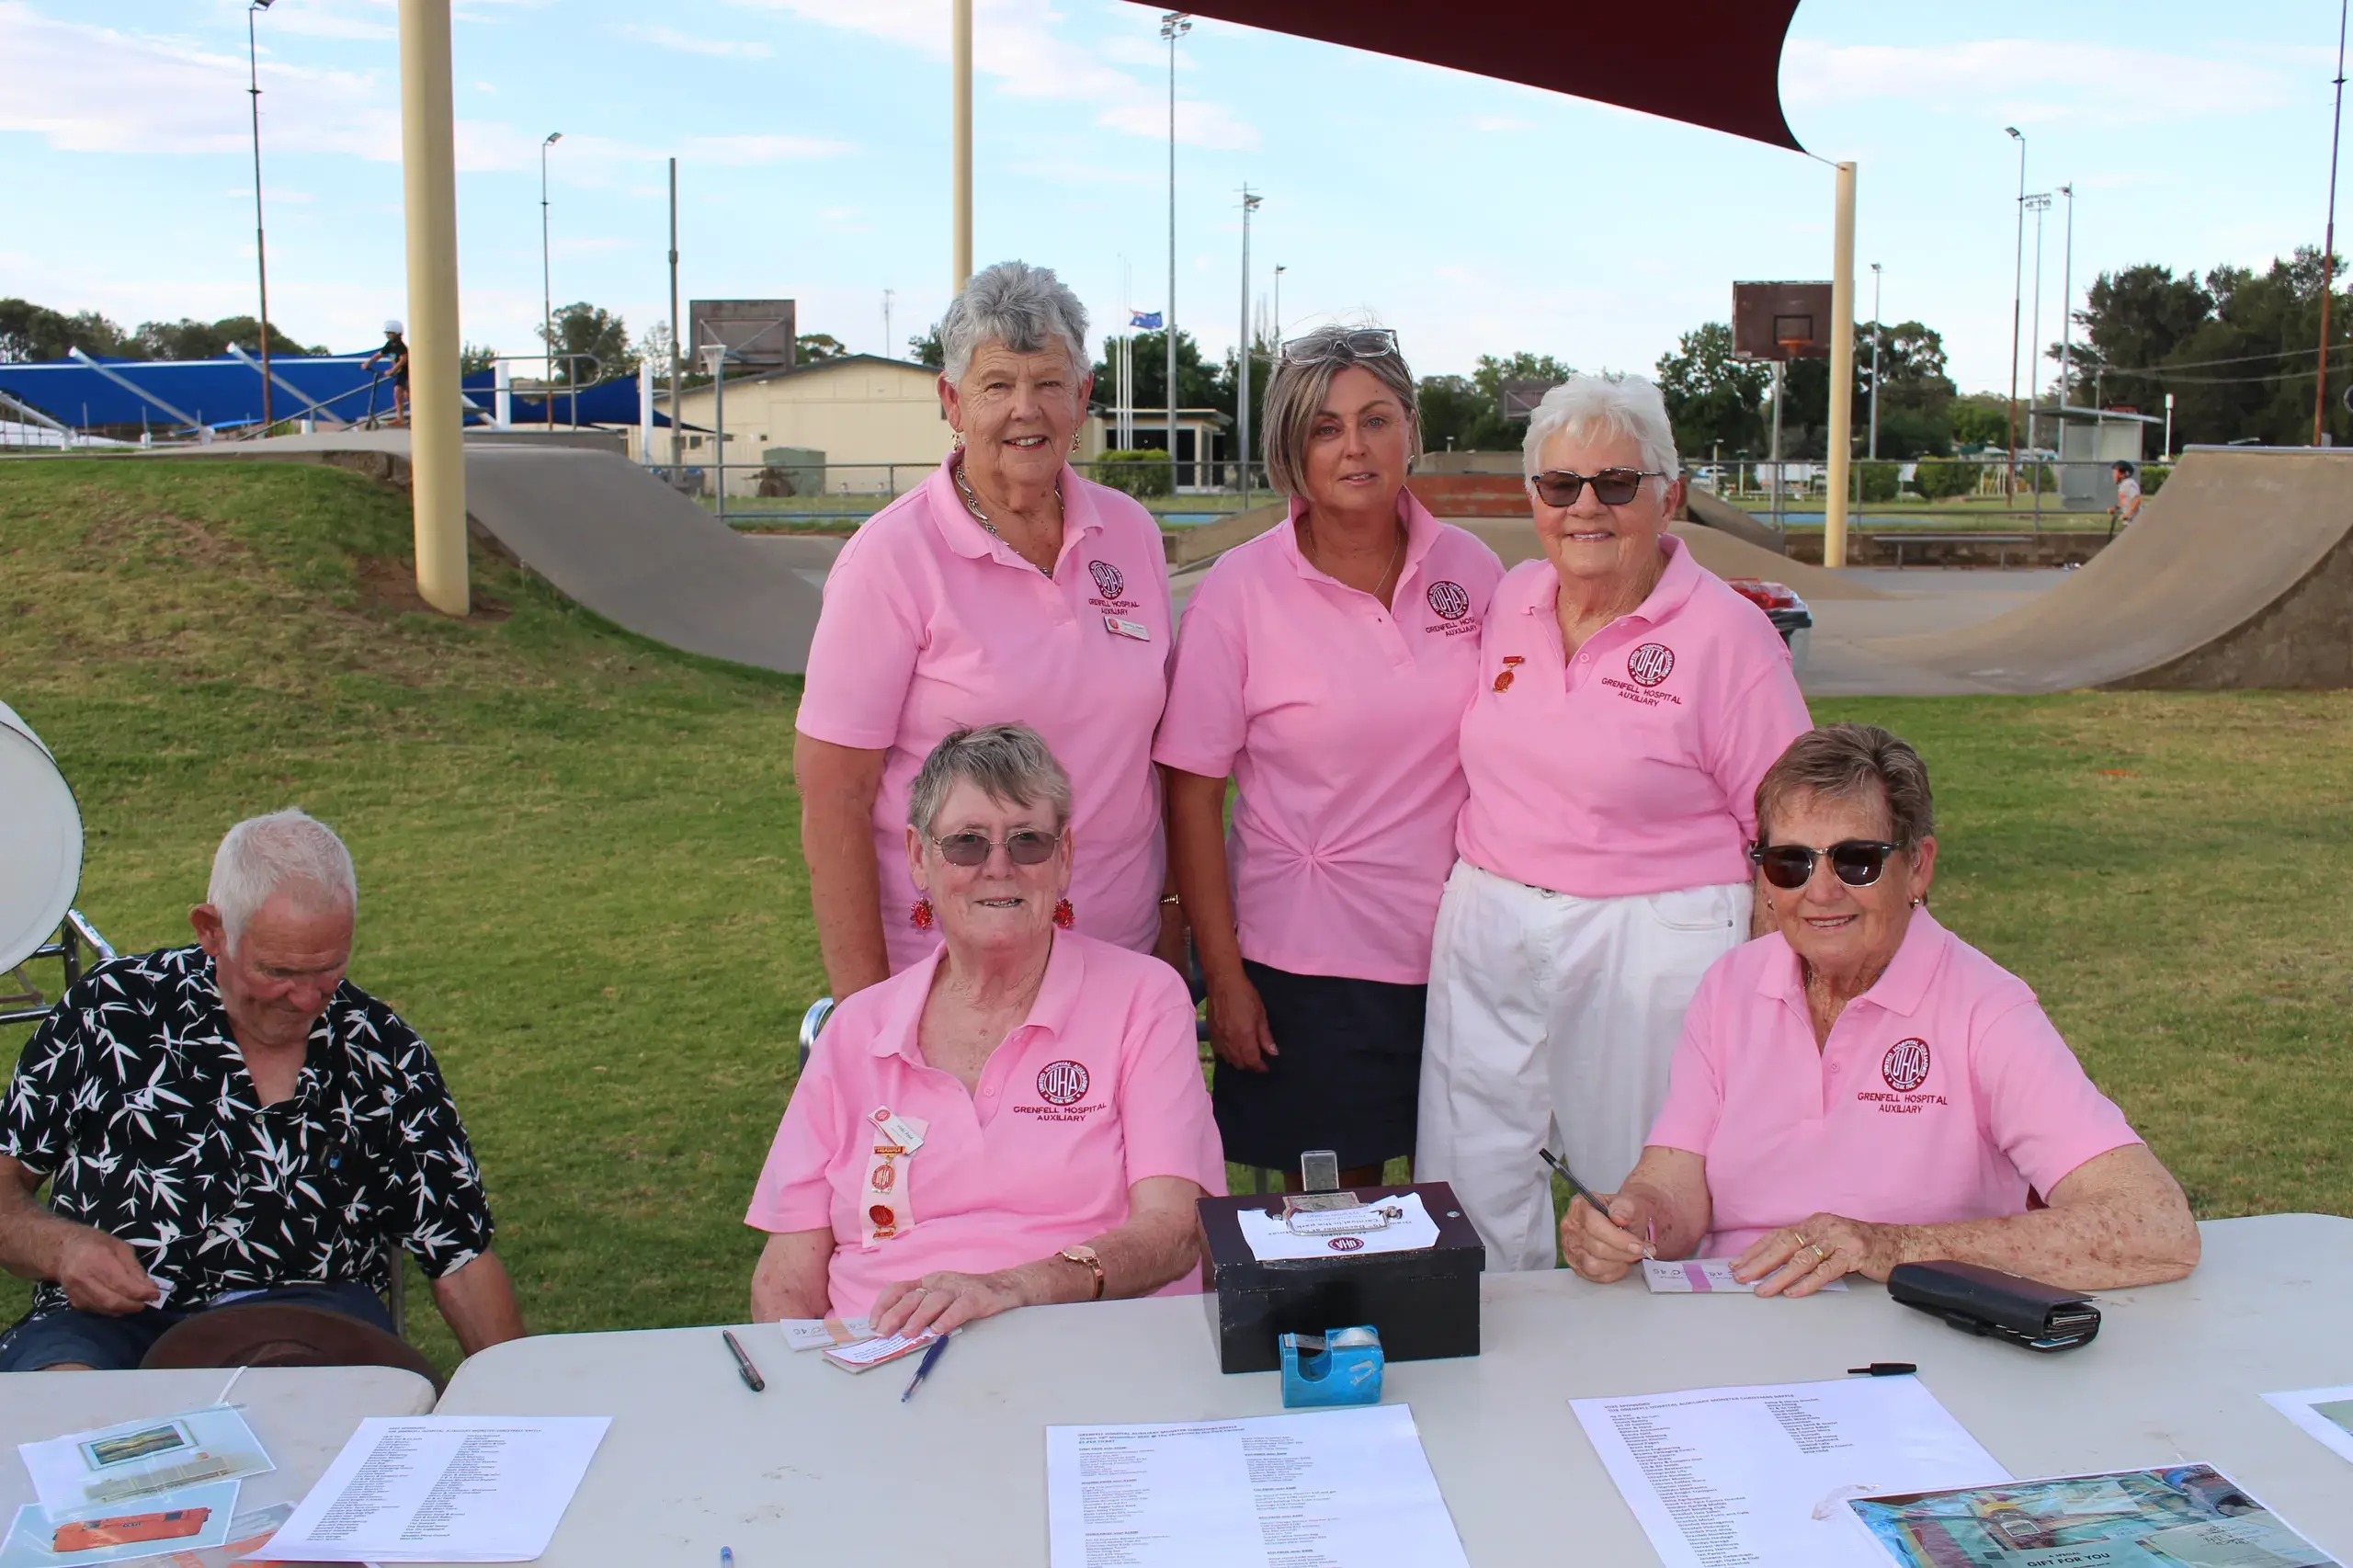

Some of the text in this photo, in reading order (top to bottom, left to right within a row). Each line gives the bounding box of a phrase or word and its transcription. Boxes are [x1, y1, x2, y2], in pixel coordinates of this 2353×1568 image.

[1434, 586, 1461, 612] UHA
[1425, 621, 1459, 633] GRENFELL
[1445, 625, 1478, 637] AUXILIARY
[1636, 649, 1665, 678] UHA
[1601, 677, 1682, 705] GRENFELL HOSPITAL
[1618, 690, 1660, 707] AUXILIARY
[1893, 1047, 1920, 1082] UHA
[1049, 1067, 1078, 1096] UHA
[1858, 1092, 1948, 1106] GRENFELL HOSPITAL
[1013, 1102, 1107, 1114] GRENFELL HOSPITAL
[1878, 1104, 1923, 1114] AUXILIARY
[1336, 1239, 1357, 1250] UHA
[2084, 1552, 2110, 1561] YOU
